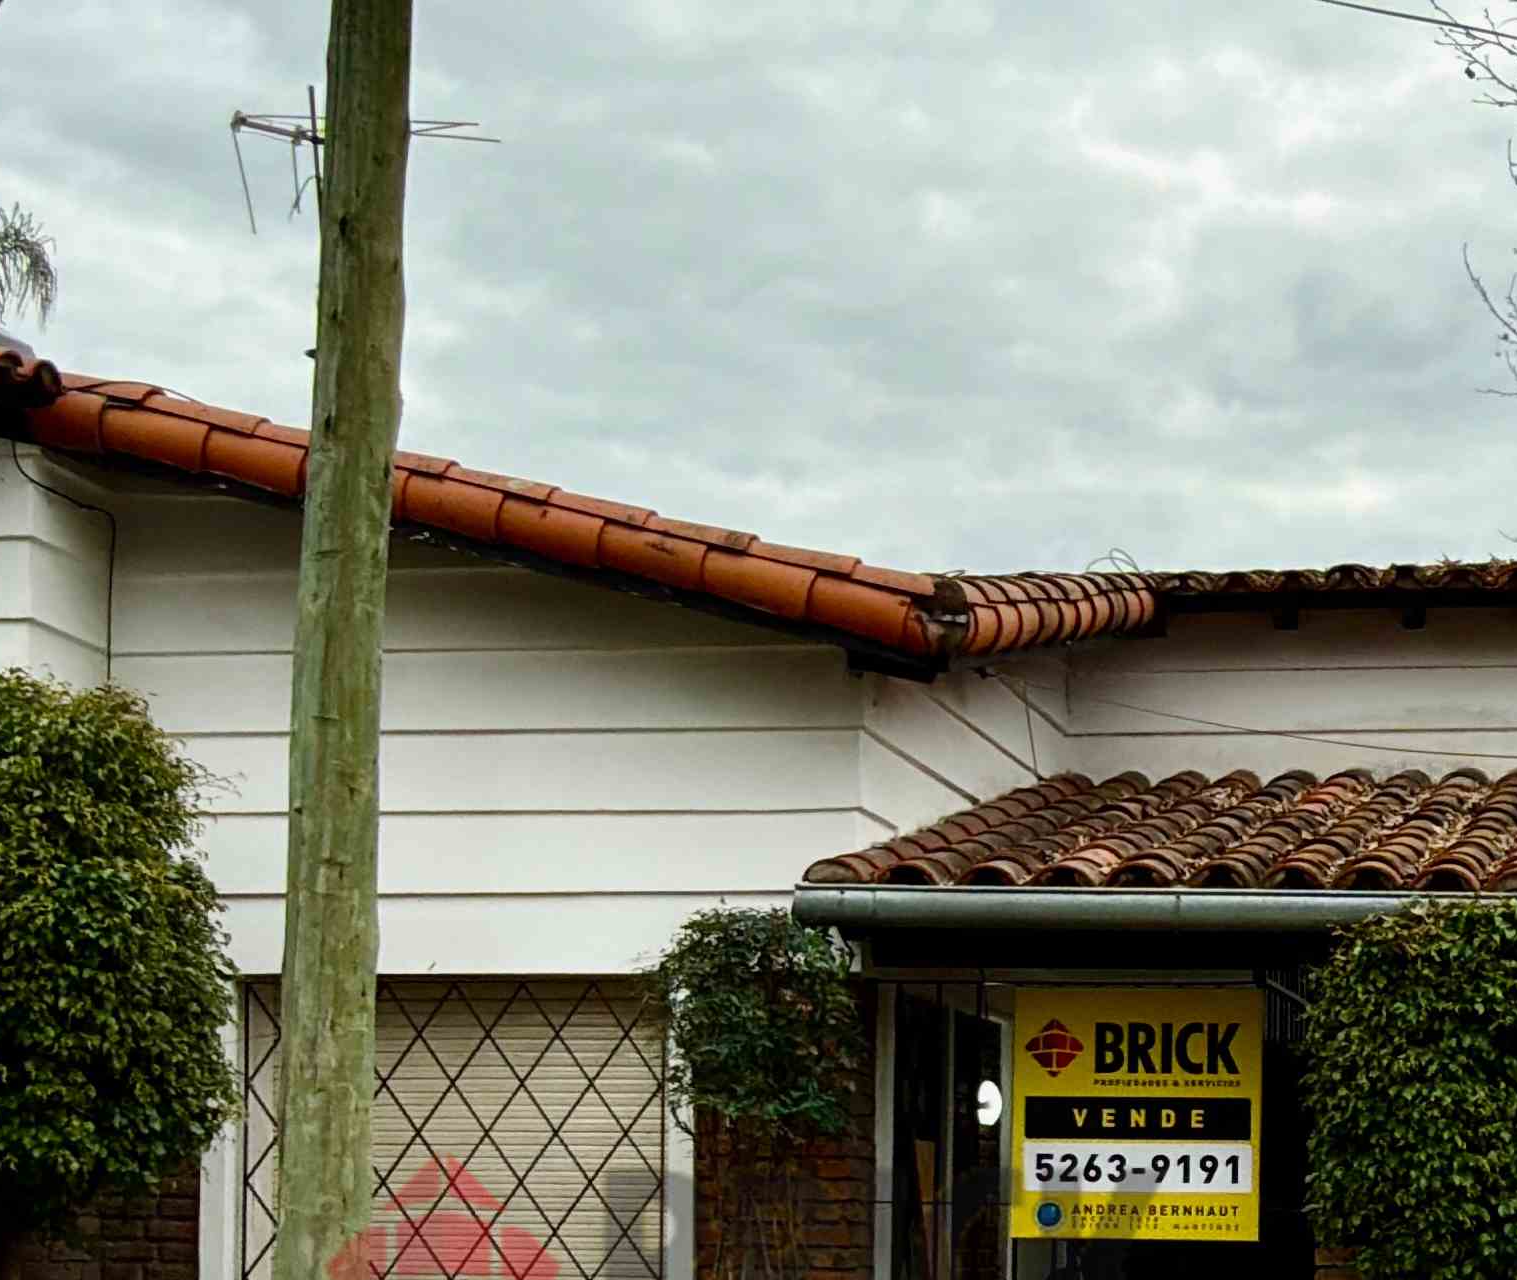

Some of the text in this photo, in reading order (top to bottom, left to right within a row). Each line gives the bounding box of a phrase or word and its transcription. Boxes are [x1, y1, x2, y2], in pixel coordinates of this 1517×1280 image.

[1093, 1022, 1241, 1075] BRICK
[1072, 1107, 1205, 1129] VENDE
[1034, 1152, 1241, 1185] 5263-9191
[1071, 1203, 1240, 1217] ANDREA BERNHAUT
